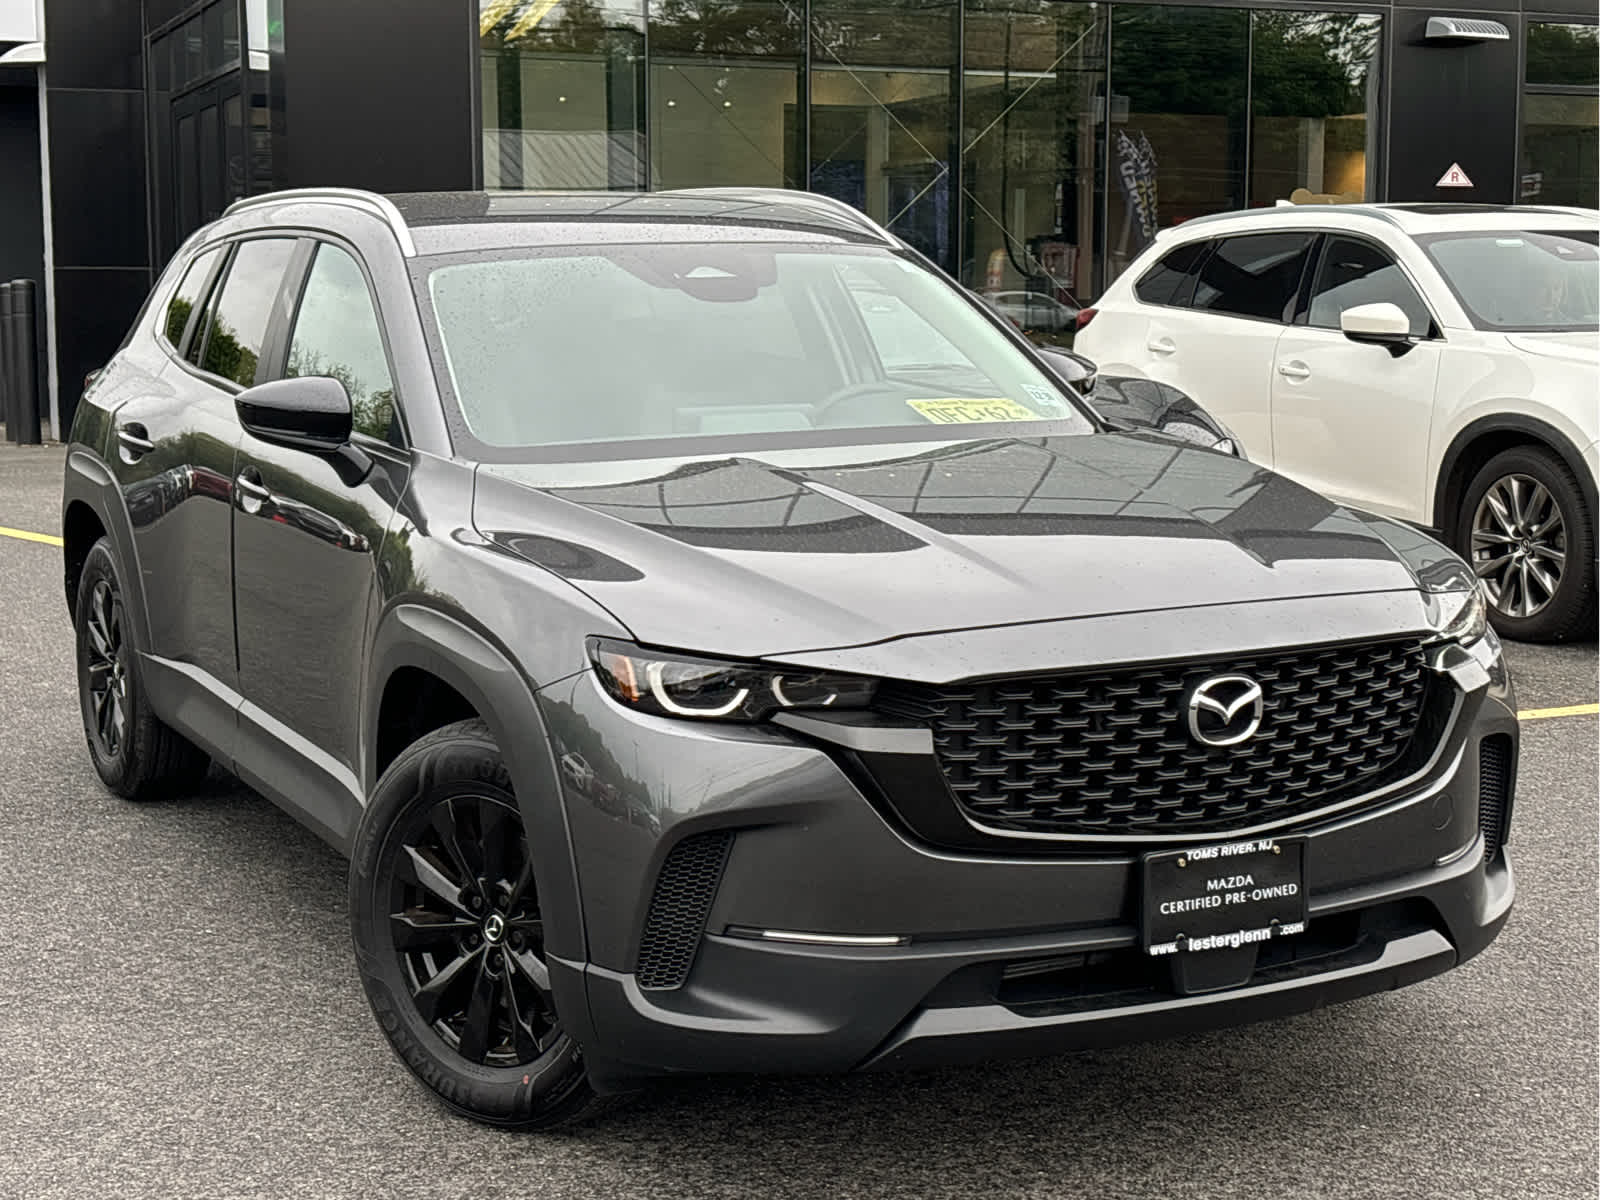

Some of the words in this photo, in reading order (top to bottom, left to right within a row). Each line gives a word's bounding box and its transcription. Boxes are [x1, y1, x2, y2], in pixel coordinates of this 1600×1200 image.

[1450, 171, 1461, 183] R
[1186, 848, 1218, 861] TOMS
[1258, 839, 1274, 851] NJ
[1206, 874, 1255, 891] MAZDA
[1160, 896, 1222, 915] CERTIFIED
[1225, 883, 1299, 905] PRE-OWNED
[1188, 927, 1272, 951] lesterglenn
[1279, 921, 1305, 936] .com
